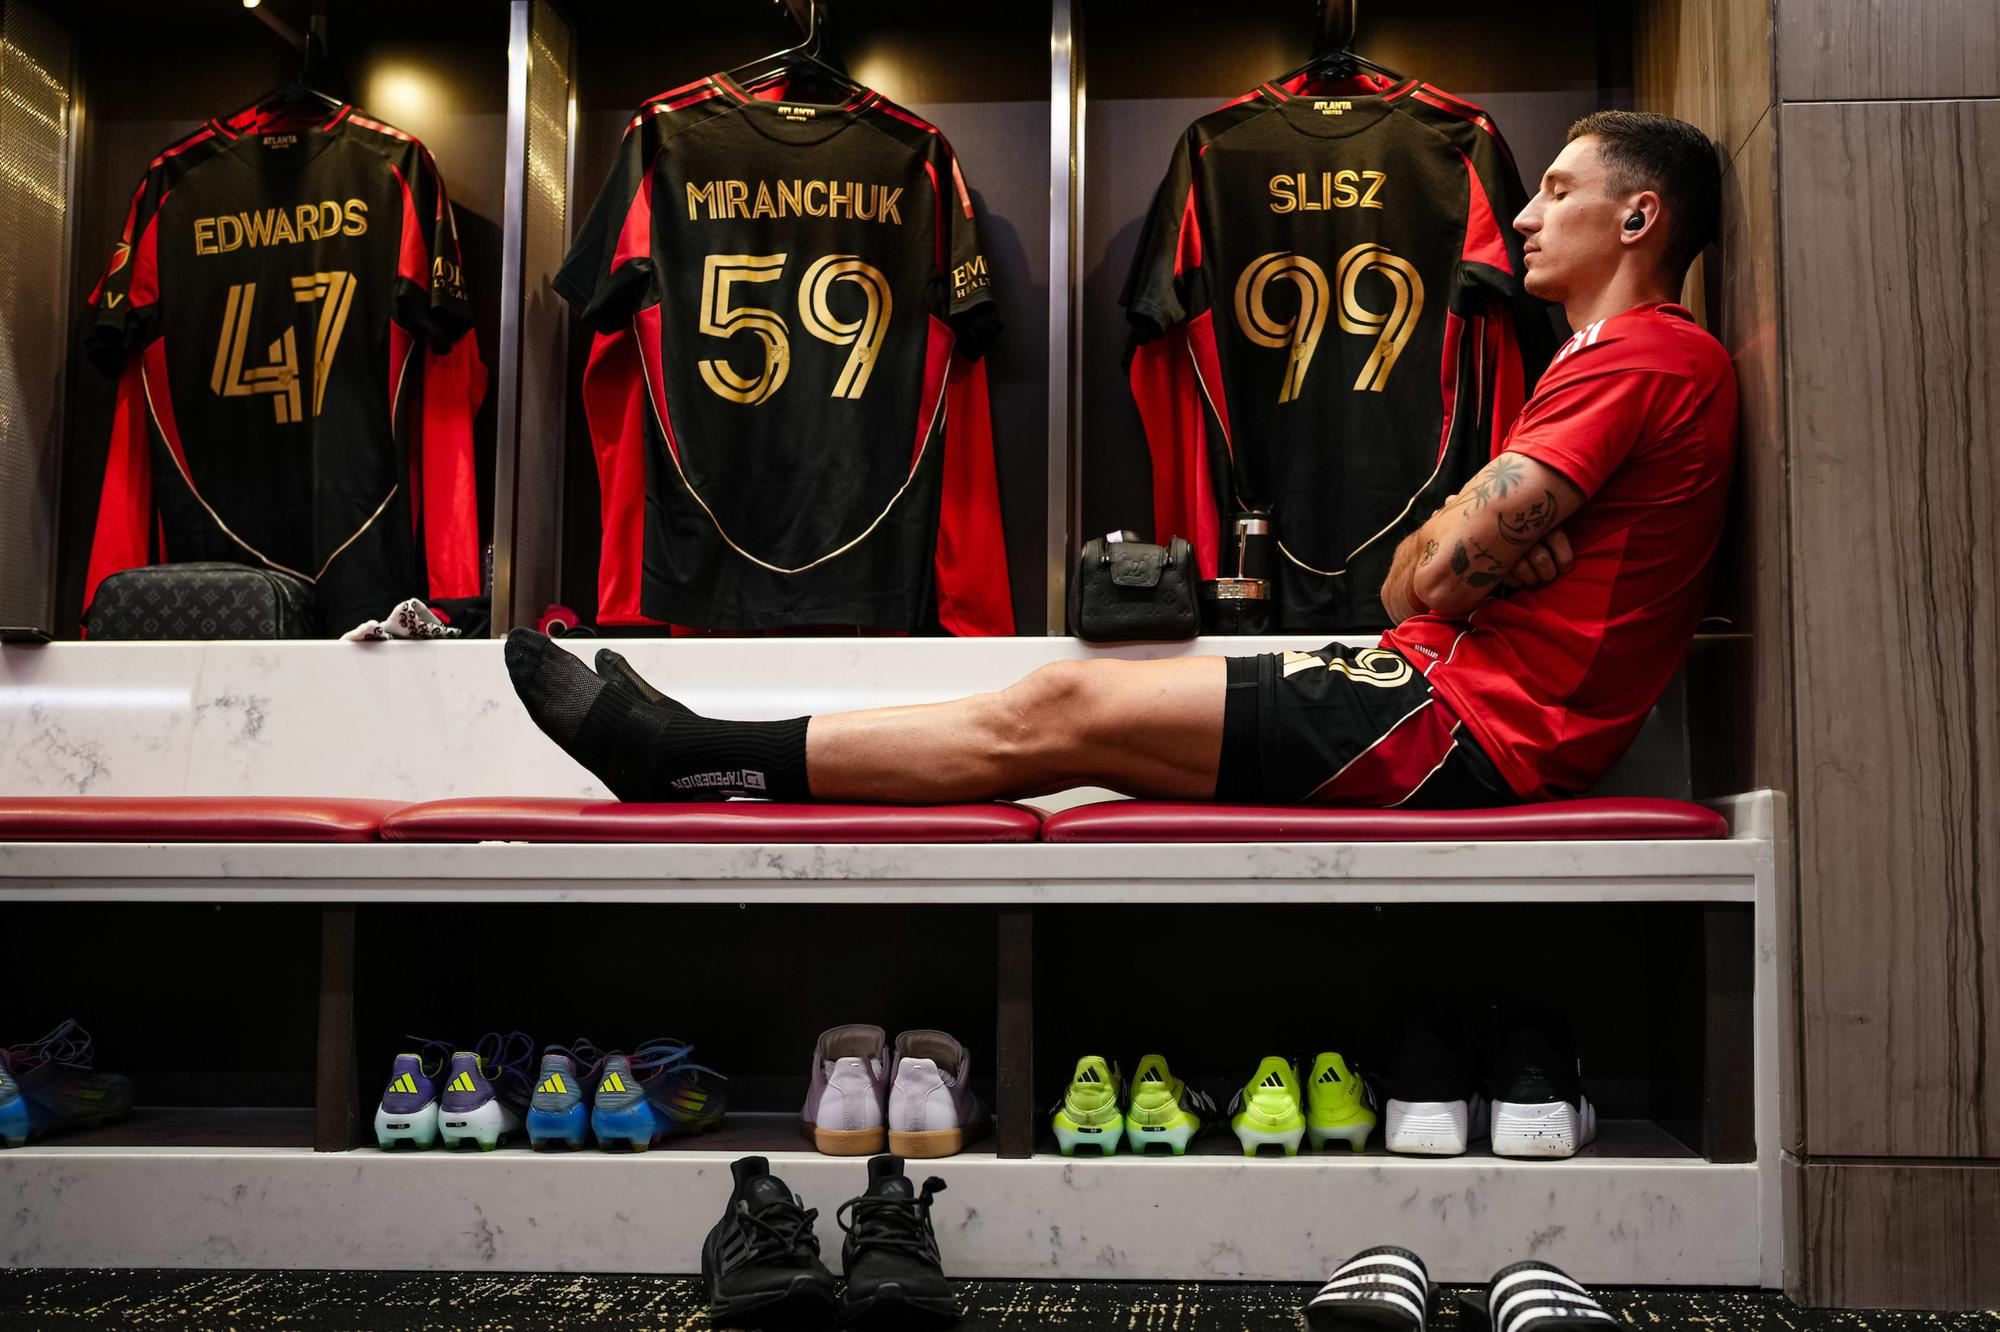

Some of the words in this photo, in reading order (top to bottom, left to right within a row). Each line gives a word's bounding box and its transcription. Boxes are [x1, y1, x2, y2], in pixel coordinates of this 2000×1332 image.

[1313, 101, 1352, 110] ATLANTA
[685, 179, 904, 225] MIRANCHUK
[1269, 169, 1387, 214] SLISZ
[194, 199, 368, 256] EDWARDS
[210, 271, 357, 424] 47
[698, 253, 893, 406] 59
[1234, 242, 1425, 404] 99
[671, 771, 744, 789] TAPEDESIGN
